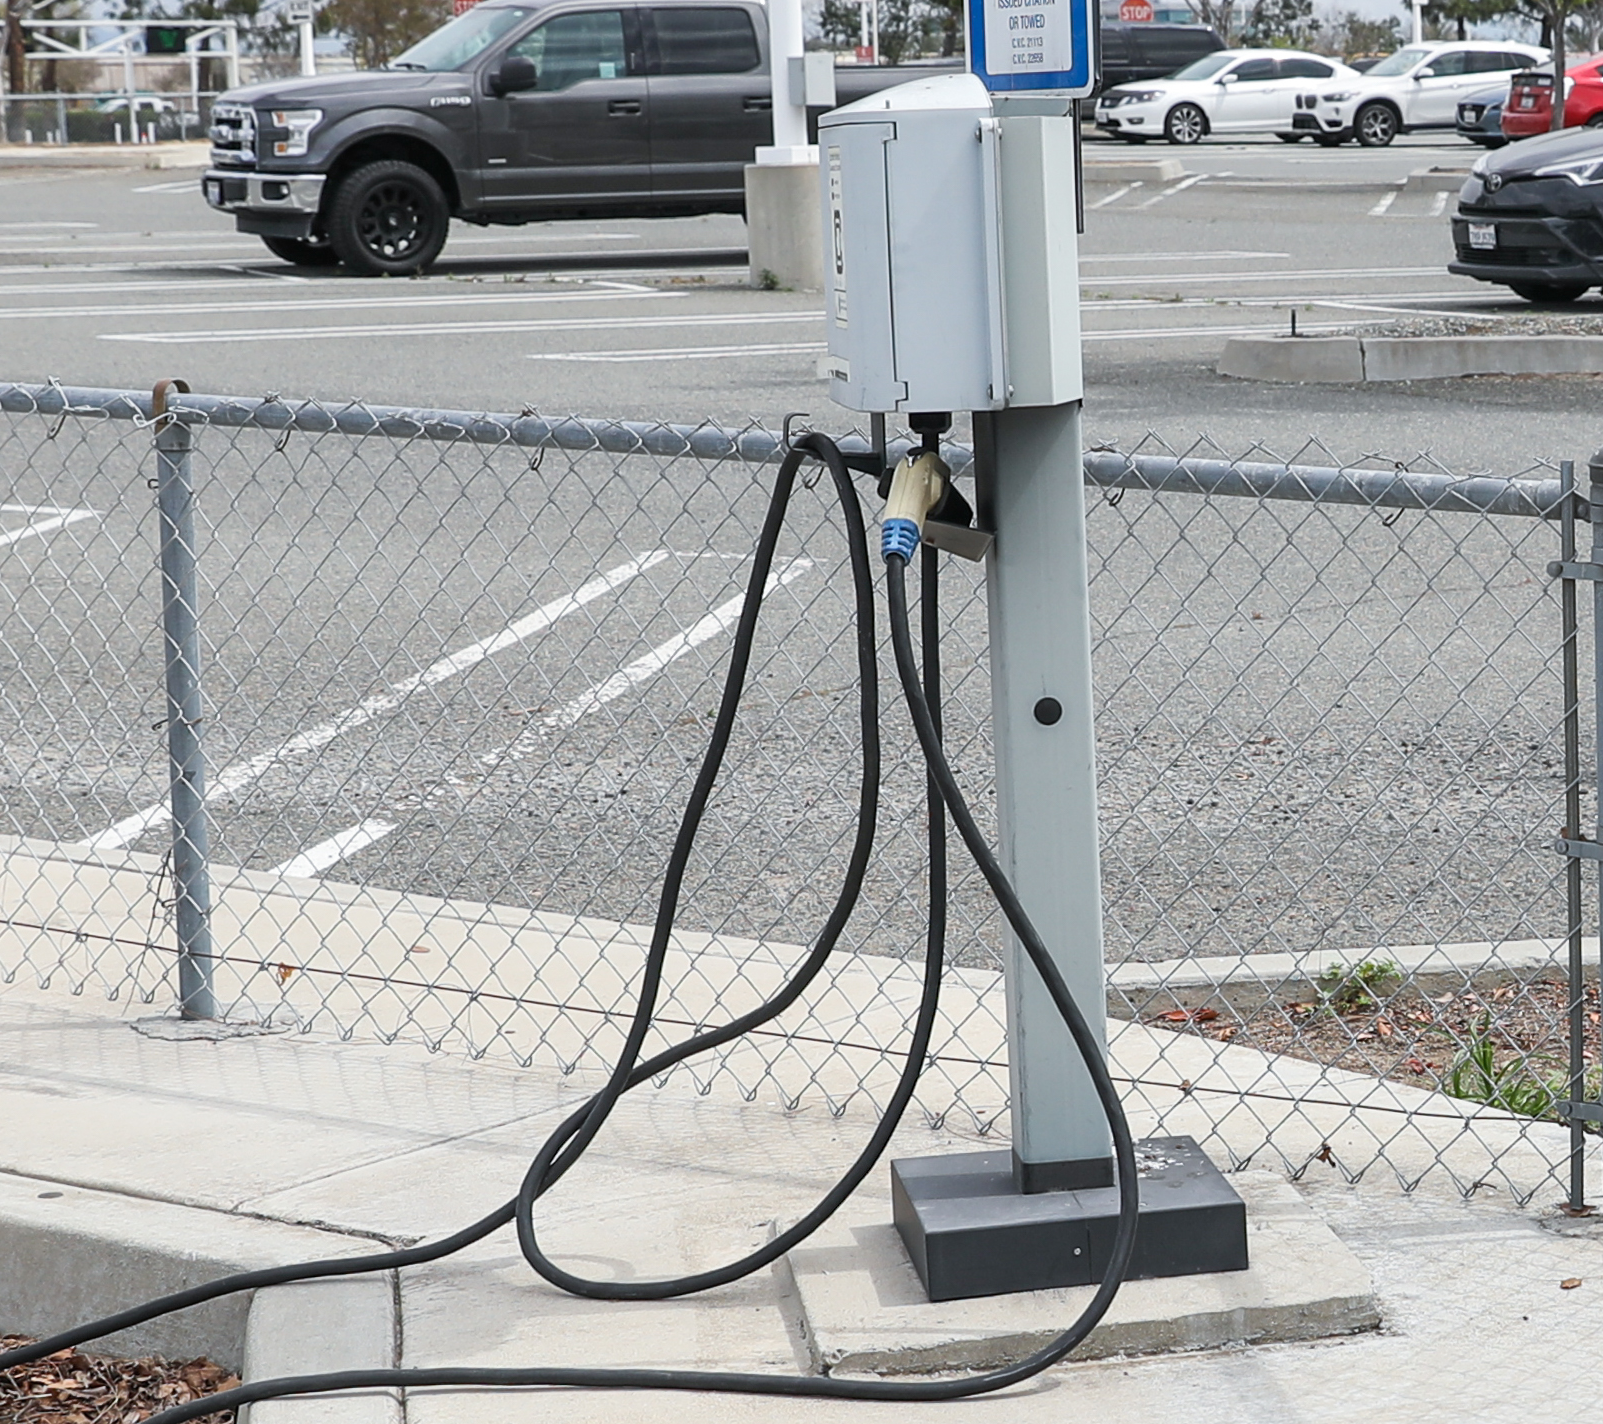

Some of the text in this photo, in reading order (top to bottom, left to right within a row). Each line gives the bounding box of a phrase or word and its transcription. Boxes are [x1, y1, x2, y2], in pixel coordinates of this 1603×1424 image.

[1122, 6, 1151, 19] STOP
[1009, 13, 1046, 30] OR TOWED
